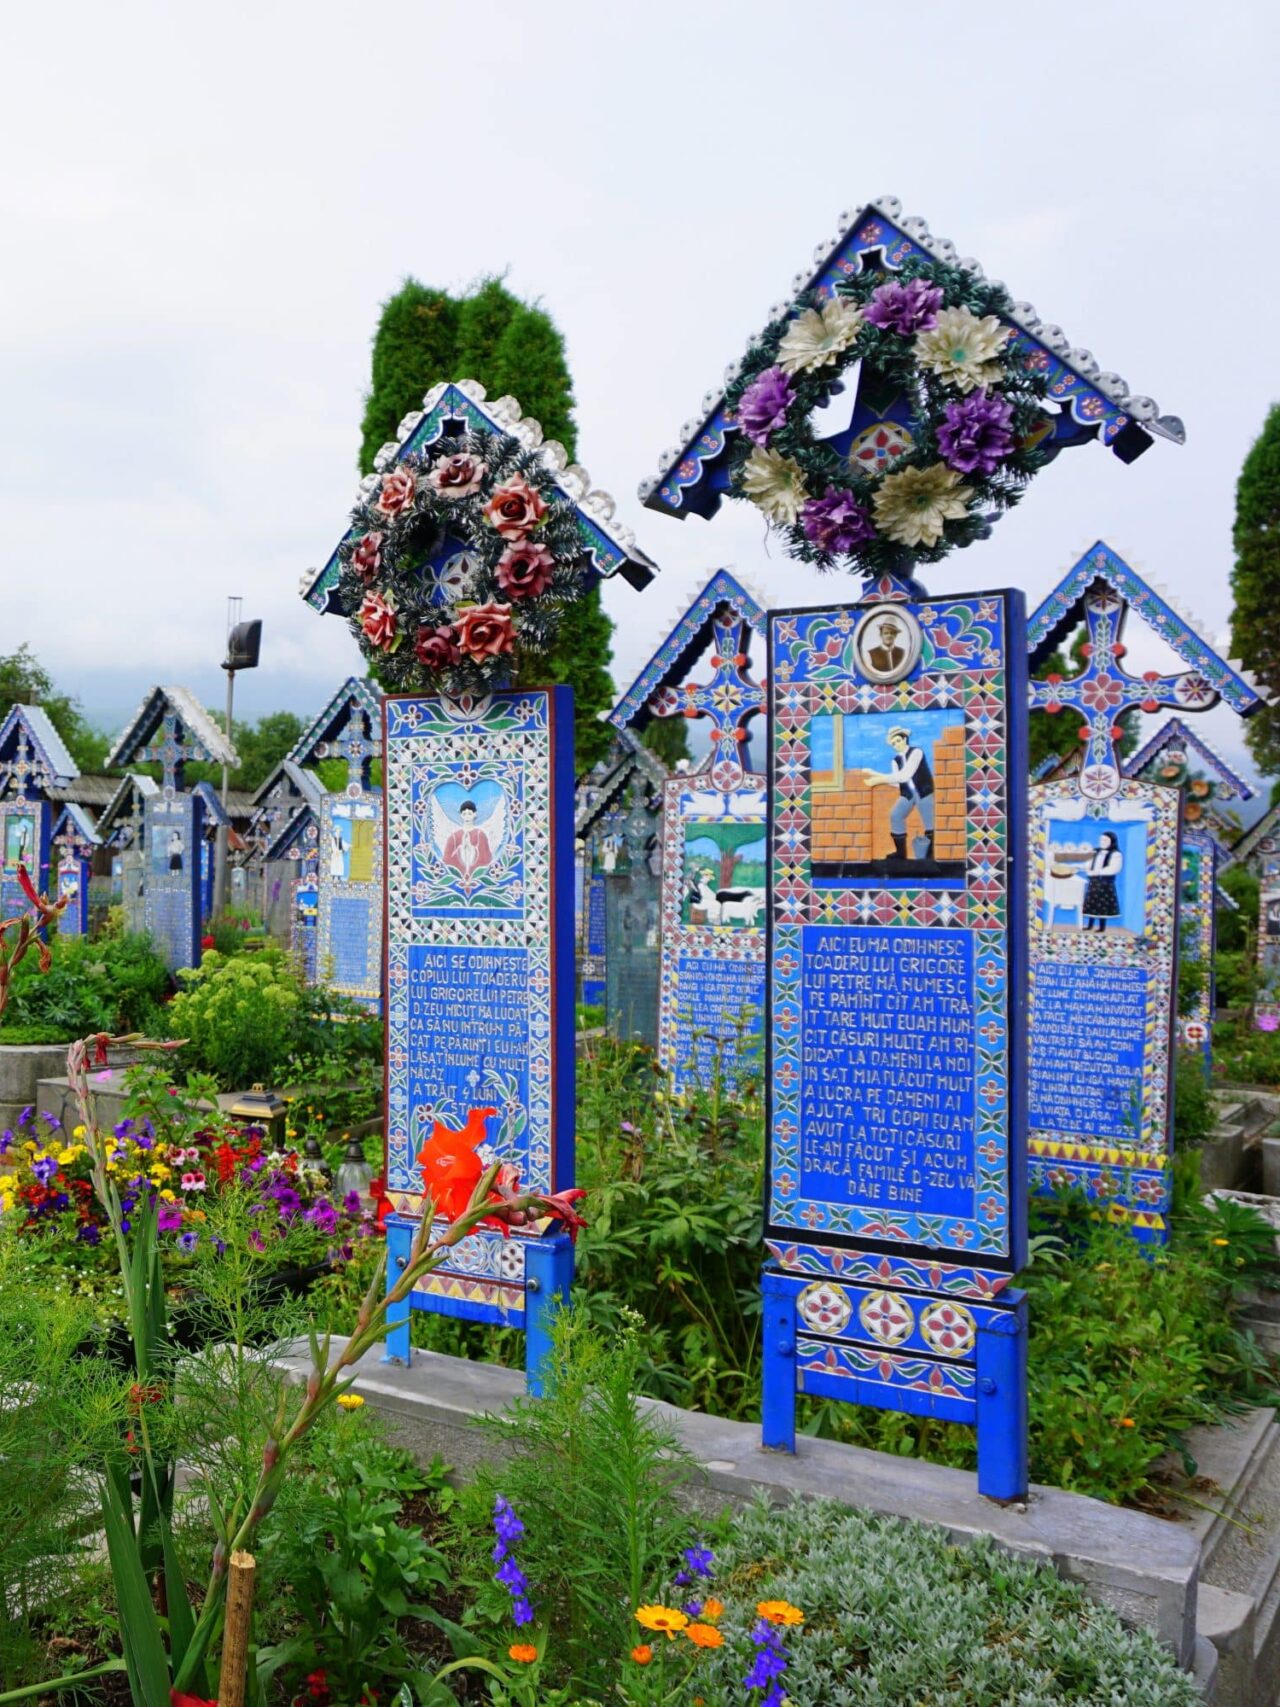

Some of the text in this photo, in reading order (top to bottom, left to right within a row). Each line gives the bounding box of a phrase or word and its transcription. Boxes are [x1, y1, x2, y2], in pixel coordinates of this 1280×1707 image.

[818, 936, 846, 952] AICI
[850, 937, 866, 953] EU
[892, 939, 965, 956] ODIHNESC
[424, 954, 446, 968] AICI
[451, 955, 466, 969] SE
[805, 954, 966, 976] TOADERU LUI GRIGORE
[410, 970, 528, 987] COPILU LUI TOADERU
[804, 974, 826, 988] LUI
[830, 974, 872, 990] PETRE
[902, 977, 966, 994] NUMESC
[410, 985, 427, 999] LUI
[500, 990, 528, 1004] PETRE
[810, 992, 826, 1008] PE
[410, 1018, 424, 1030] CA
[442, 1019, 458, 1032] NU
[804, 1010, 820, 1024] IT
[822, 1010, 857, 1028] TARE
[860, 1012, 894, 1029] MULT
[410, 1034, 430, 1048] CAT
[434, 1036, 446, 1049] PE
[494, 1040, 509, 1054] EU
[804, 1029, 828, 1044] CIT
[882, 1033, 926, 1050] MULTE
[483, 1056, 496, 1069] CU
[500, 1058, 527, 1072] MULT
[804, 1047, 844, 1063] DICAT
[848, 1050, 866, 1064] LA
[926, 1056, 942, 1070] LA
[946, 1057, 970, 1072] NOI
[822, 1067, 848, 1084] SAT
[936, 1074, 972, 1092] MULT
[413, 1082, 422, 1096] A
[472, 1087, 497, 1102] LUNI
[804, 1084, 816, 1098] A
[818, 1086, 862, 1102] LUCRA
[866, 1088, 882, 1104] PE
[944, 1095, 961, 1111] AI
[806, 1102, 974, 1132] AJUTA TRI COPII EU AM
[805, 1120, 844, 1138] AVUT
[850, 1124, 866, 1141] LA
[888, 1185, 924, 1204] BINE
